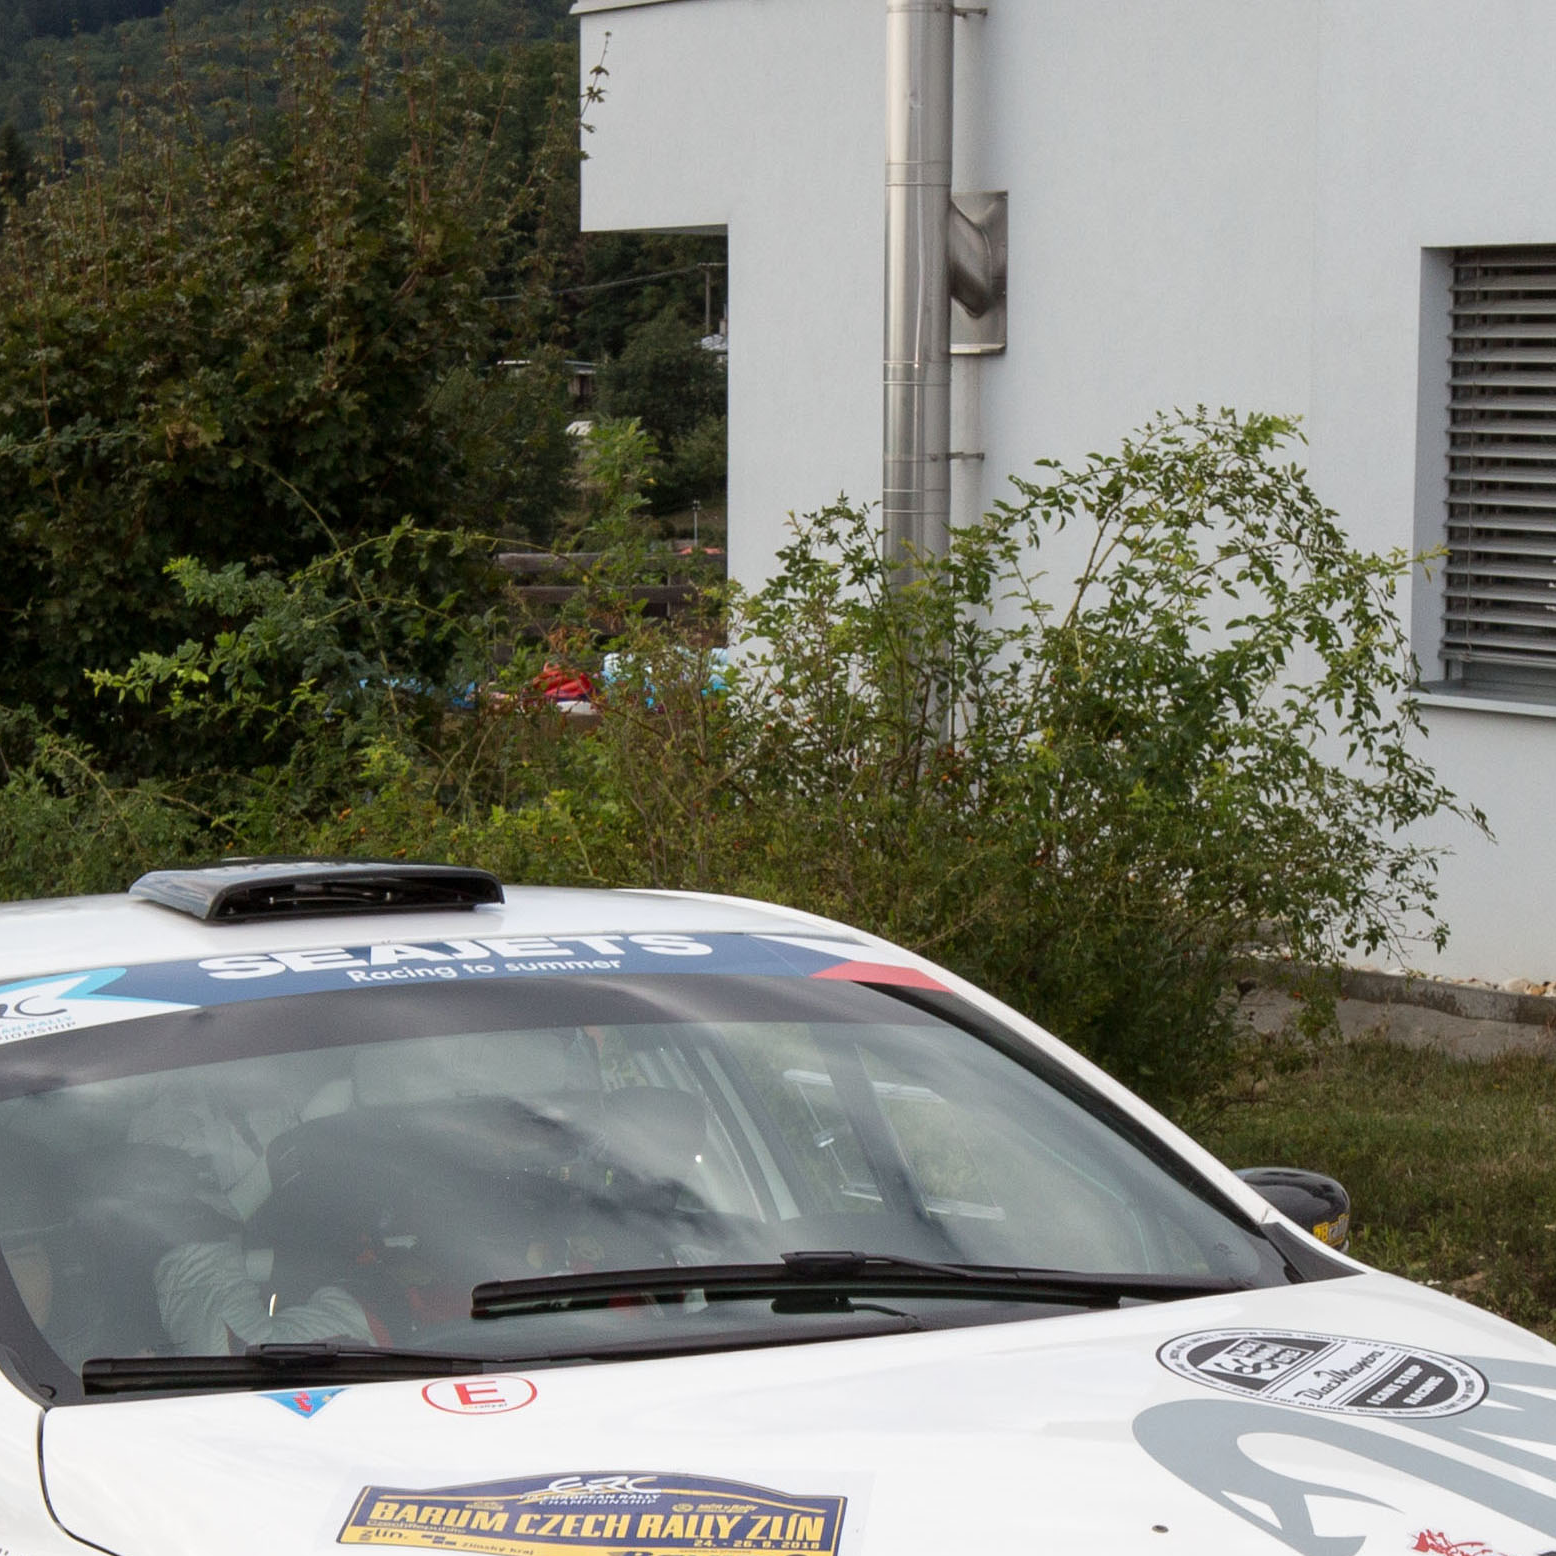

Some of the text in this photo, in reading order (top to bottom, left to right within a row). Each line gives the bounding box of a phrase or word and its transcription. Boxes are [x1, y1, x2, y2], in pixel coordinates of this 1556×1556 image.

[198, 934, 713, 980] SEAJETS
[346, 956, 622, 983] Racing to summer
[453, 1380, 506, 1406] E
[369, 1500, 826, 1542] BARUM CZECH RALLY ZLÍN
[693, 1539, 718, 1548] 24.
